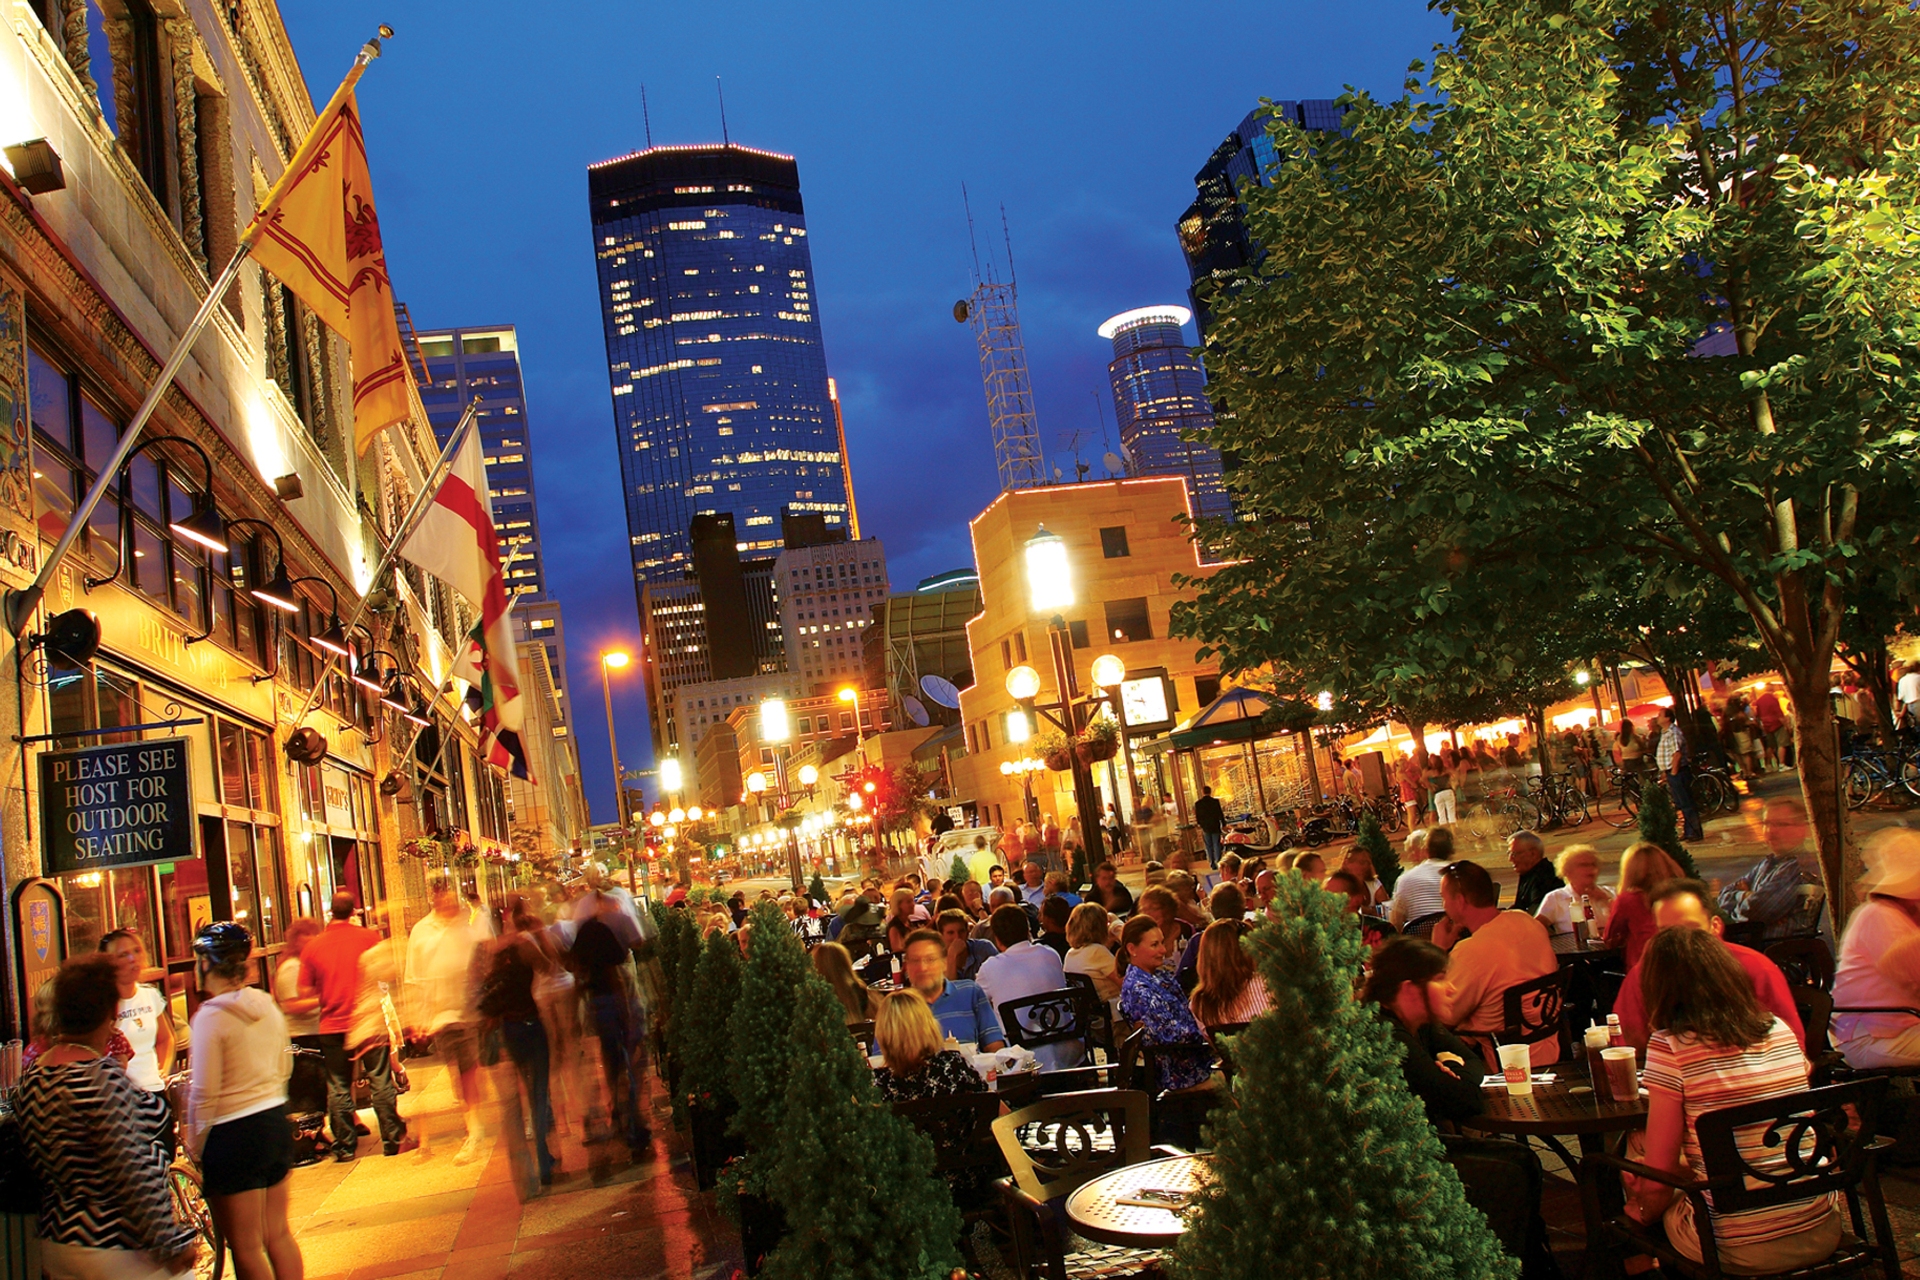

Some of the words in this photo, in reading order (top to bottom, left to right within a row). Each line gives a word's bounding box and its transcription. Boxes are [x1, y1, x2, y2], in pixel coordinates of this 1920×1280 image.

[52, 752, 131, 783] PLEASE
[138, 747, 178, 773] SEE
[65, 780, 120, 809] HOST
[127, 775, 169, 801] FOR
[66, 801, 170, 834] OUTDOOR
[73, 828, 165, 861] SEATING
